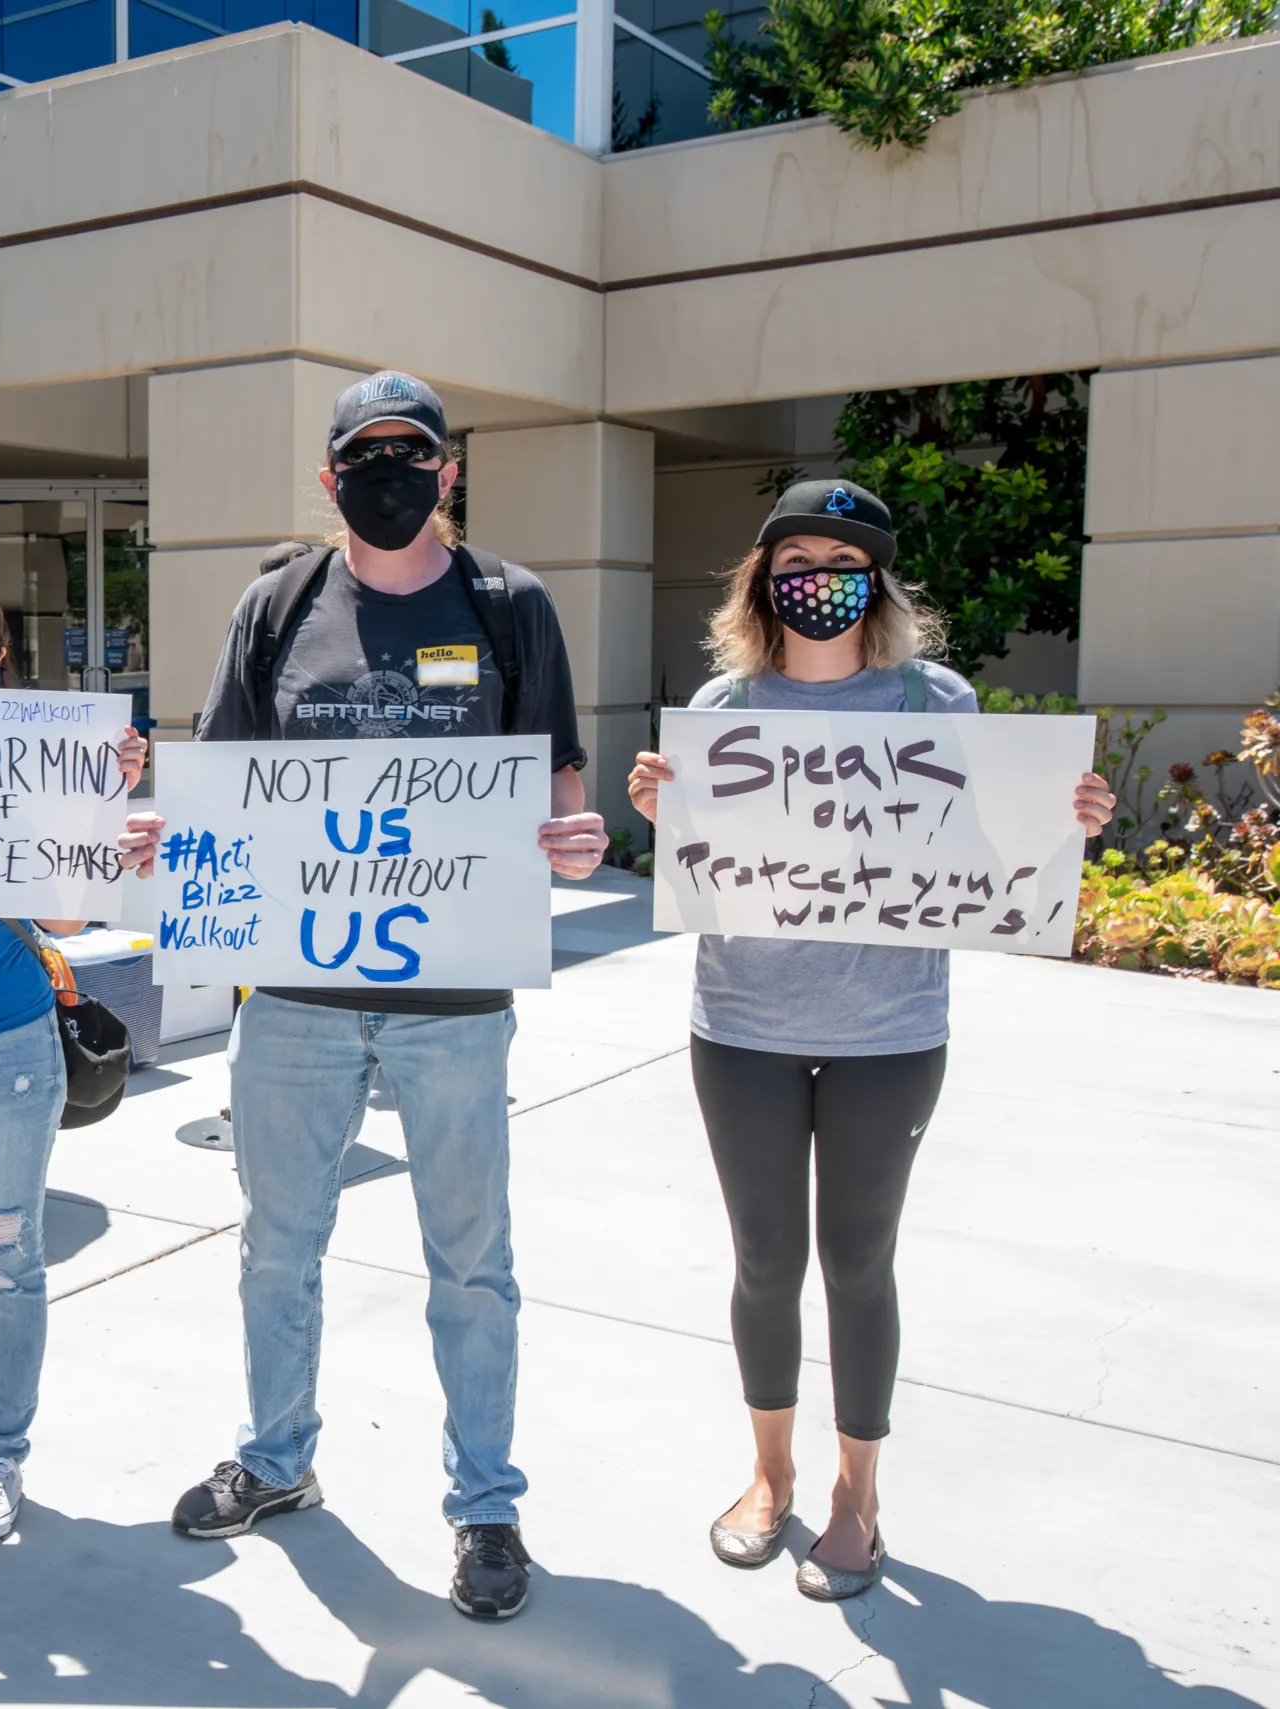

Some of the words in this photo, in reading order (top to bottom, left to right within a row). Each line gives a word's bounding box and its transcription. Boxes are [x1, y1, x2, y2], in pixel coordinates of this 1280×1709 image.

[359, 376, 419, 406] BLIZZARD
[421, 648, 453, 659] hello
[39, 736, 128, 802] MIND
[242, 756, 349, 809] NOT
[364, 756, 539, 806] ABOUT
[708, 725, 967, 815] Speak
[324, 807, 412, 857] US
[813, 796, 953, 846] out!
[32, 838, 123, 884] SHAKES
[160, 826, 254, 882] #Acti
[300, 855, 488, 898] WITHOUT
[676, 841, 892, 897] Protect
[911, 866, 1037, 904] your
[182, 880, 262, 910] Blizz
[772, 900, 1064, 937] workers!
[160, 910, 262, 950] Walkout
[300, 903, 429, 983] US
